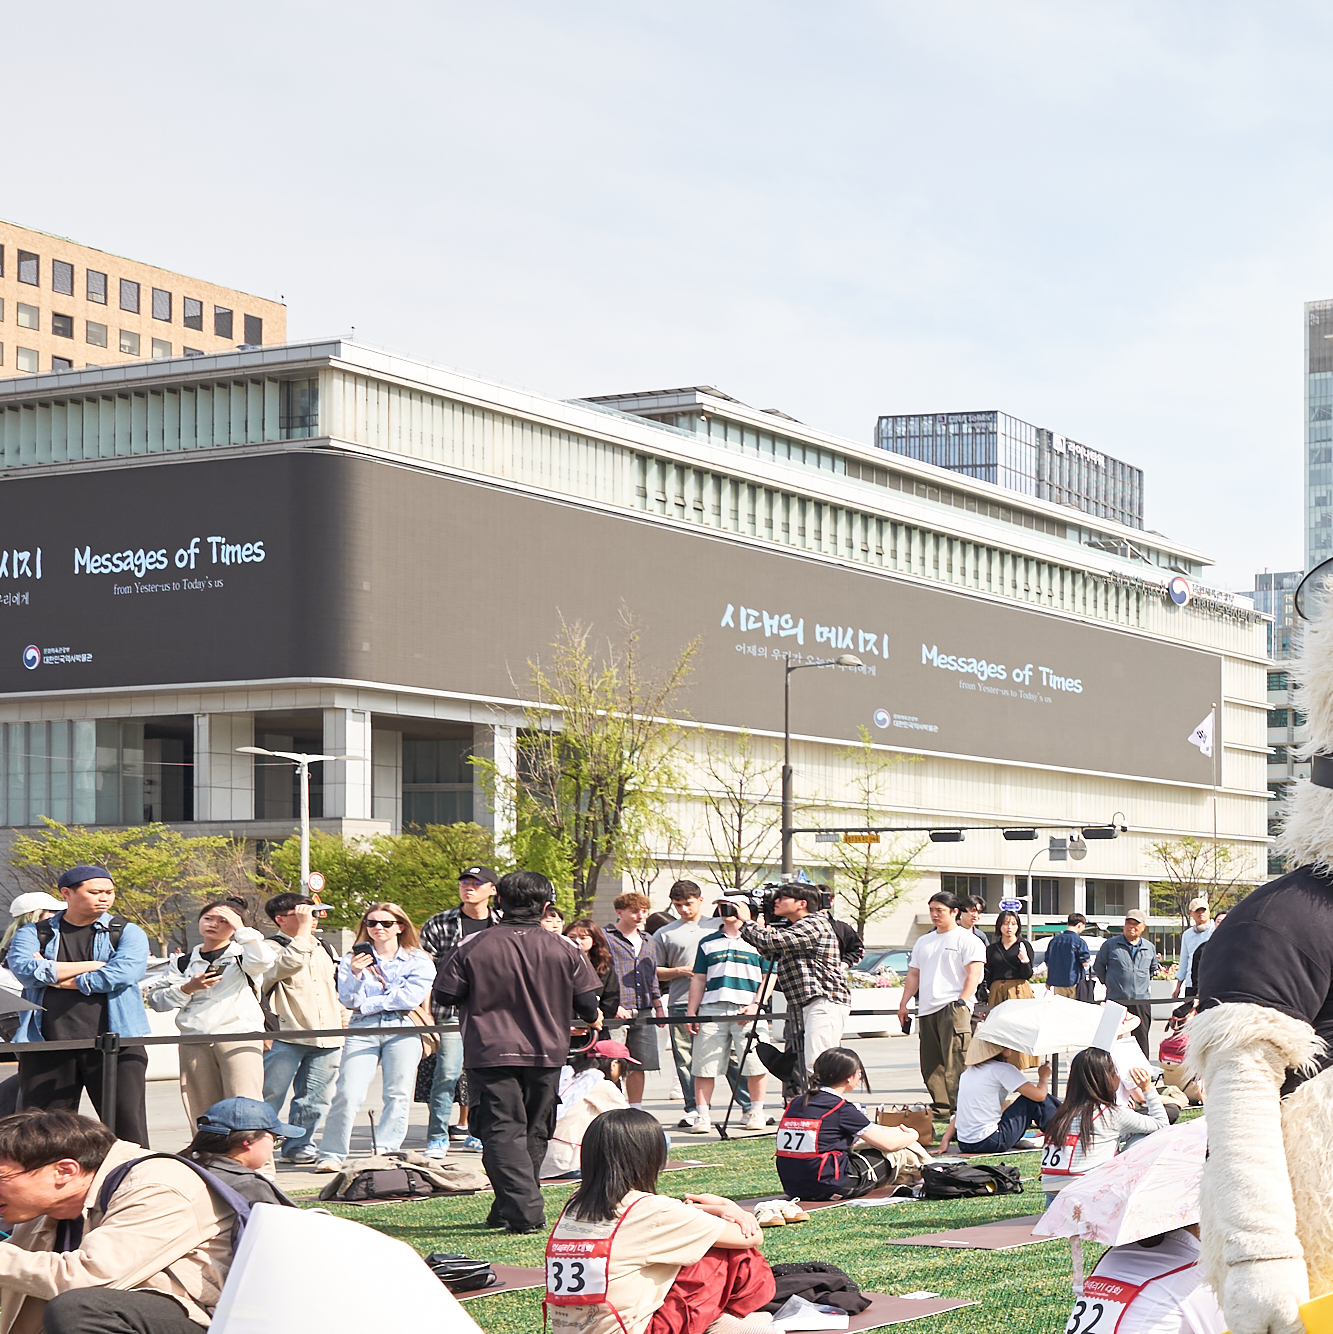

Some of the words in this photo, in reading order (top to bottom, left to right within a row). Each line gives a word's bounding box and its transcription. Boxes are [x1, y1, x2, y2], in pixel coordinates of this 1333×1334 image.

[74, 545, 169, 579] Messages
[174, 537, 201, 570] of
[207, 535, 266, 566] Times
[113, 583, 133, 595] from
[134, 581, 171, 594] Yester-us
[172, 580, 181, 591] to
[182, 575, 213, 592] Today's
[214, 577, 224, 588] us
[0, 591, 30, 606] 리에게
[721, 603, 805, 646] 시대의
[815, 623, 889, 660] 메시지
[735, 642, 768, 659] 어제의
[921, 643, 1007, 682] Messages
[1012, 663, 1034, 686] of
[1038, 665, 1084, 694] Times
[959, 679, 976, 692] from
[1010, 689, 1018, 698] to
[1044, 696, 1053, 704] us
[783, 1132, 805, 1150] 27
[1041, 1146, 1062, 1167] 26
[552, 1261, 586, 1293] 33
